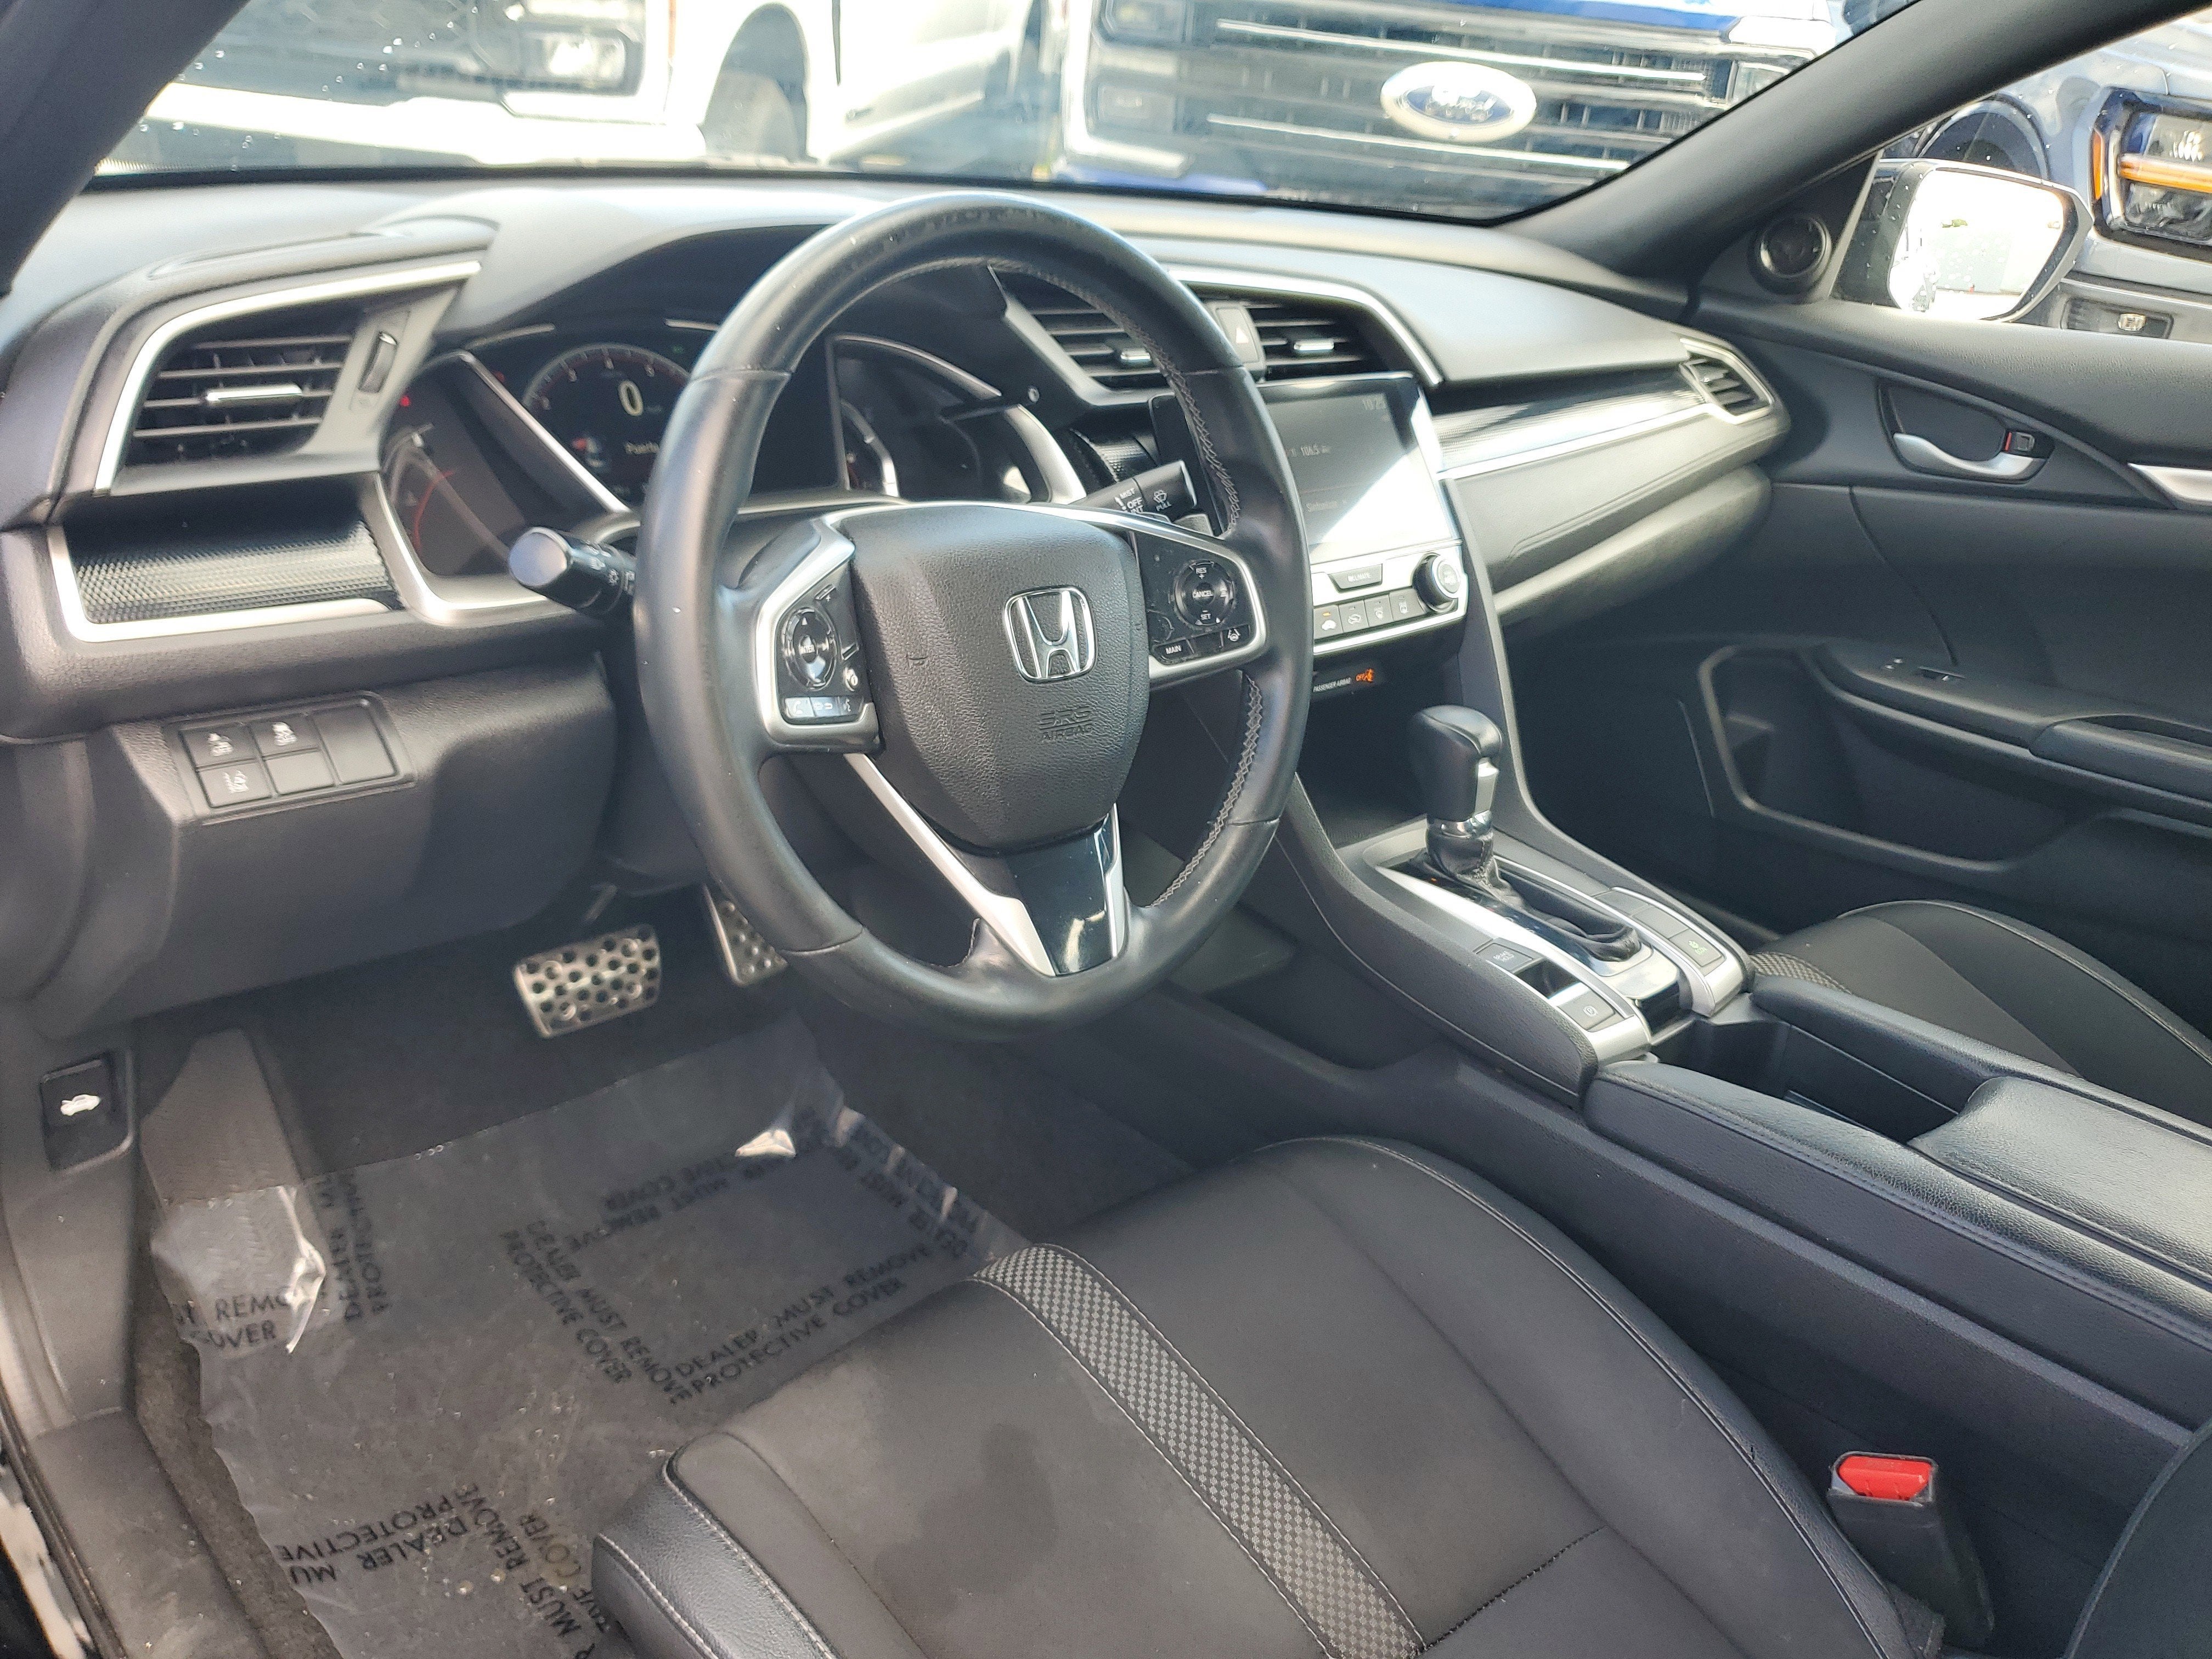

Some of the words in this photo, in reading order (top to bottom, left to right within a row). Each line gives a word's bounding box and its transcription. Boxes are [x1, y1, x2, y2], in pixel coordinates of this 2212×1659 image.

[618, 380, 644, 417] 0
[1120, 488, 1136, 499] MIST
[1126, 496, 1143, 509] OFF
[1156, 500, 1172, 512] PULL
[1192, 590, 1214, 599] CANCEL
[1165, 645, 1182, 654] MAIN
[1040, 707, 1092, 727] SRS
[775, 1285, 834, 1328] MUST
[692, 1316, 827, 1395] PROTECTIVE
[276, 1496, 454, 1561] PROTECTIVE
[358, 1519, 469, 1570] DEALER
[457, 1482, 530, 1572] REMOVE
[520, 1511, 580, 1578] COVER
[520, 1578, 582, 1637] MUST
